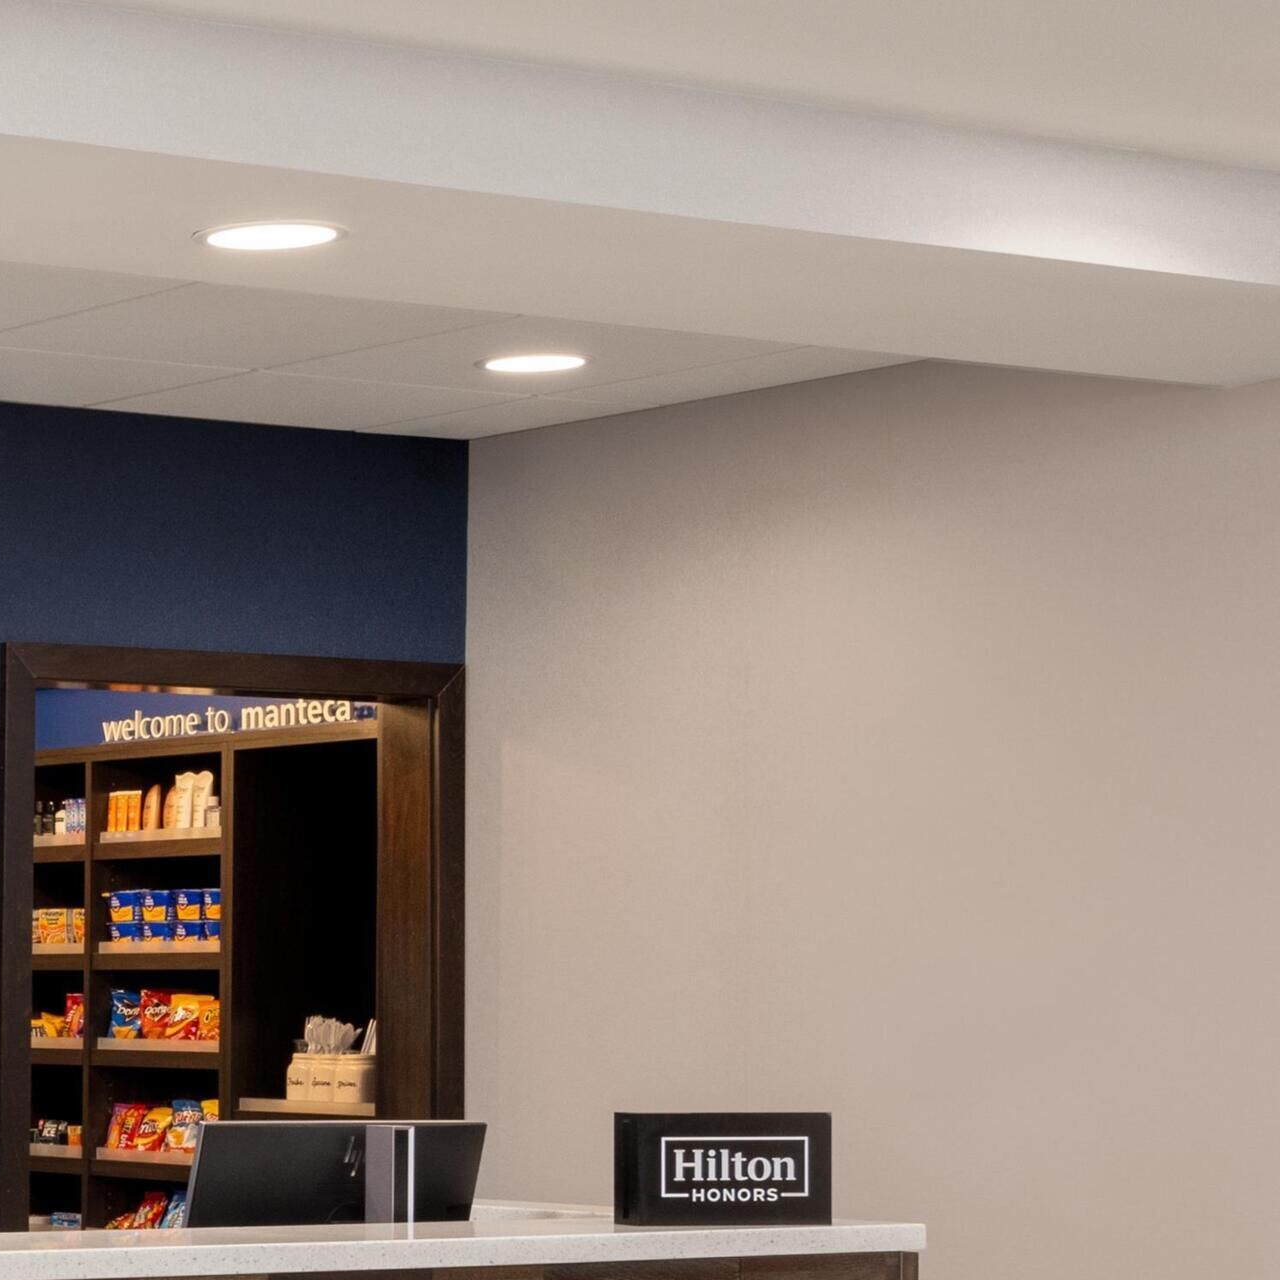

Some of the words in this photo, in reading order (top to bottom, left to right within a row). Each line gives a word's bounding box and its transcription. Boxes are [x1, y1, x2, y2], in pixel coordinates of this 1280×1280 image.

[102, 710, 201, 742] welcome
[206, 706, 232, 733] to
[240, 698, 351, 730] manteca
[673, 1149, 797, 1182] Hilton
[692, 1187, 779, 1203] HONORS
